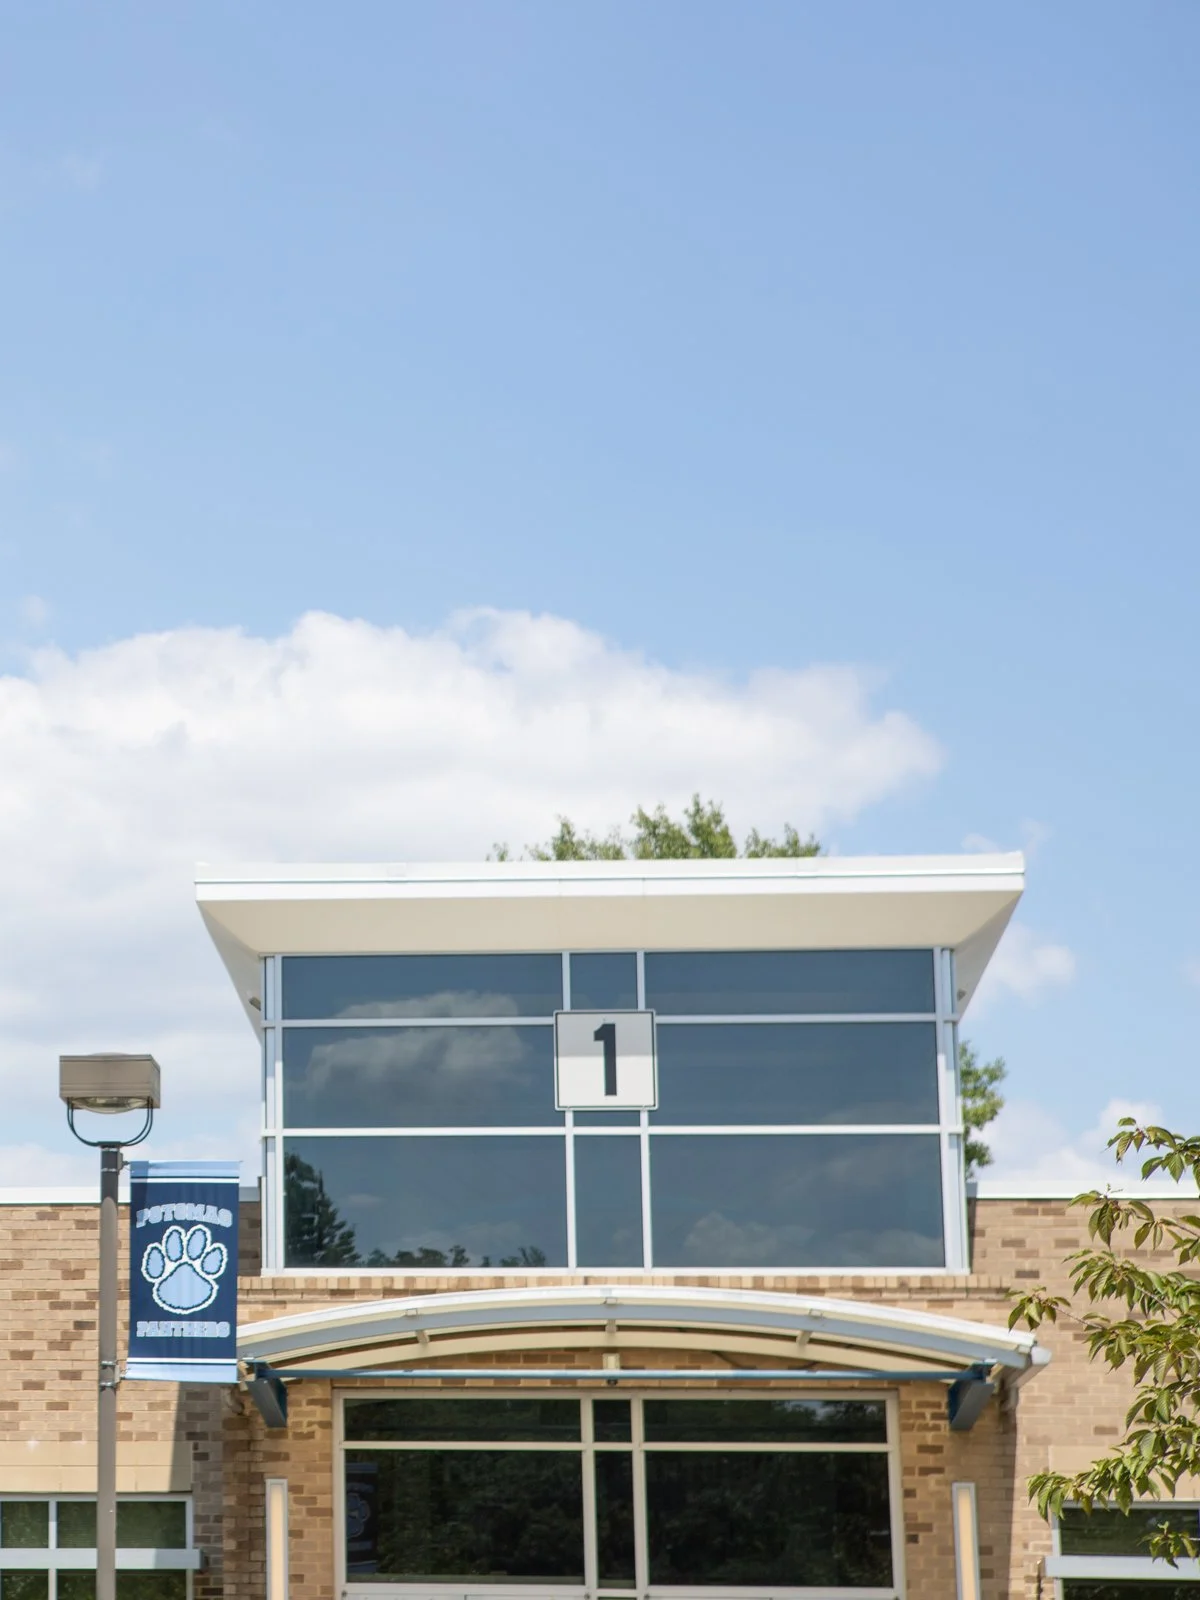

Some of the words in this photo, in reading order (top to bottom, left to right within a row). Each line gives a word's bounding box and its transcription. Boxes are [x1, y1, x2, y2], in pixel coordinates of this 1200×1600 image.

[593, 1023, 618, 1096] 1
[136, 1202, 233, 1229] POTOMAC
[136, 1320, 231, 1338] PANTHERS
